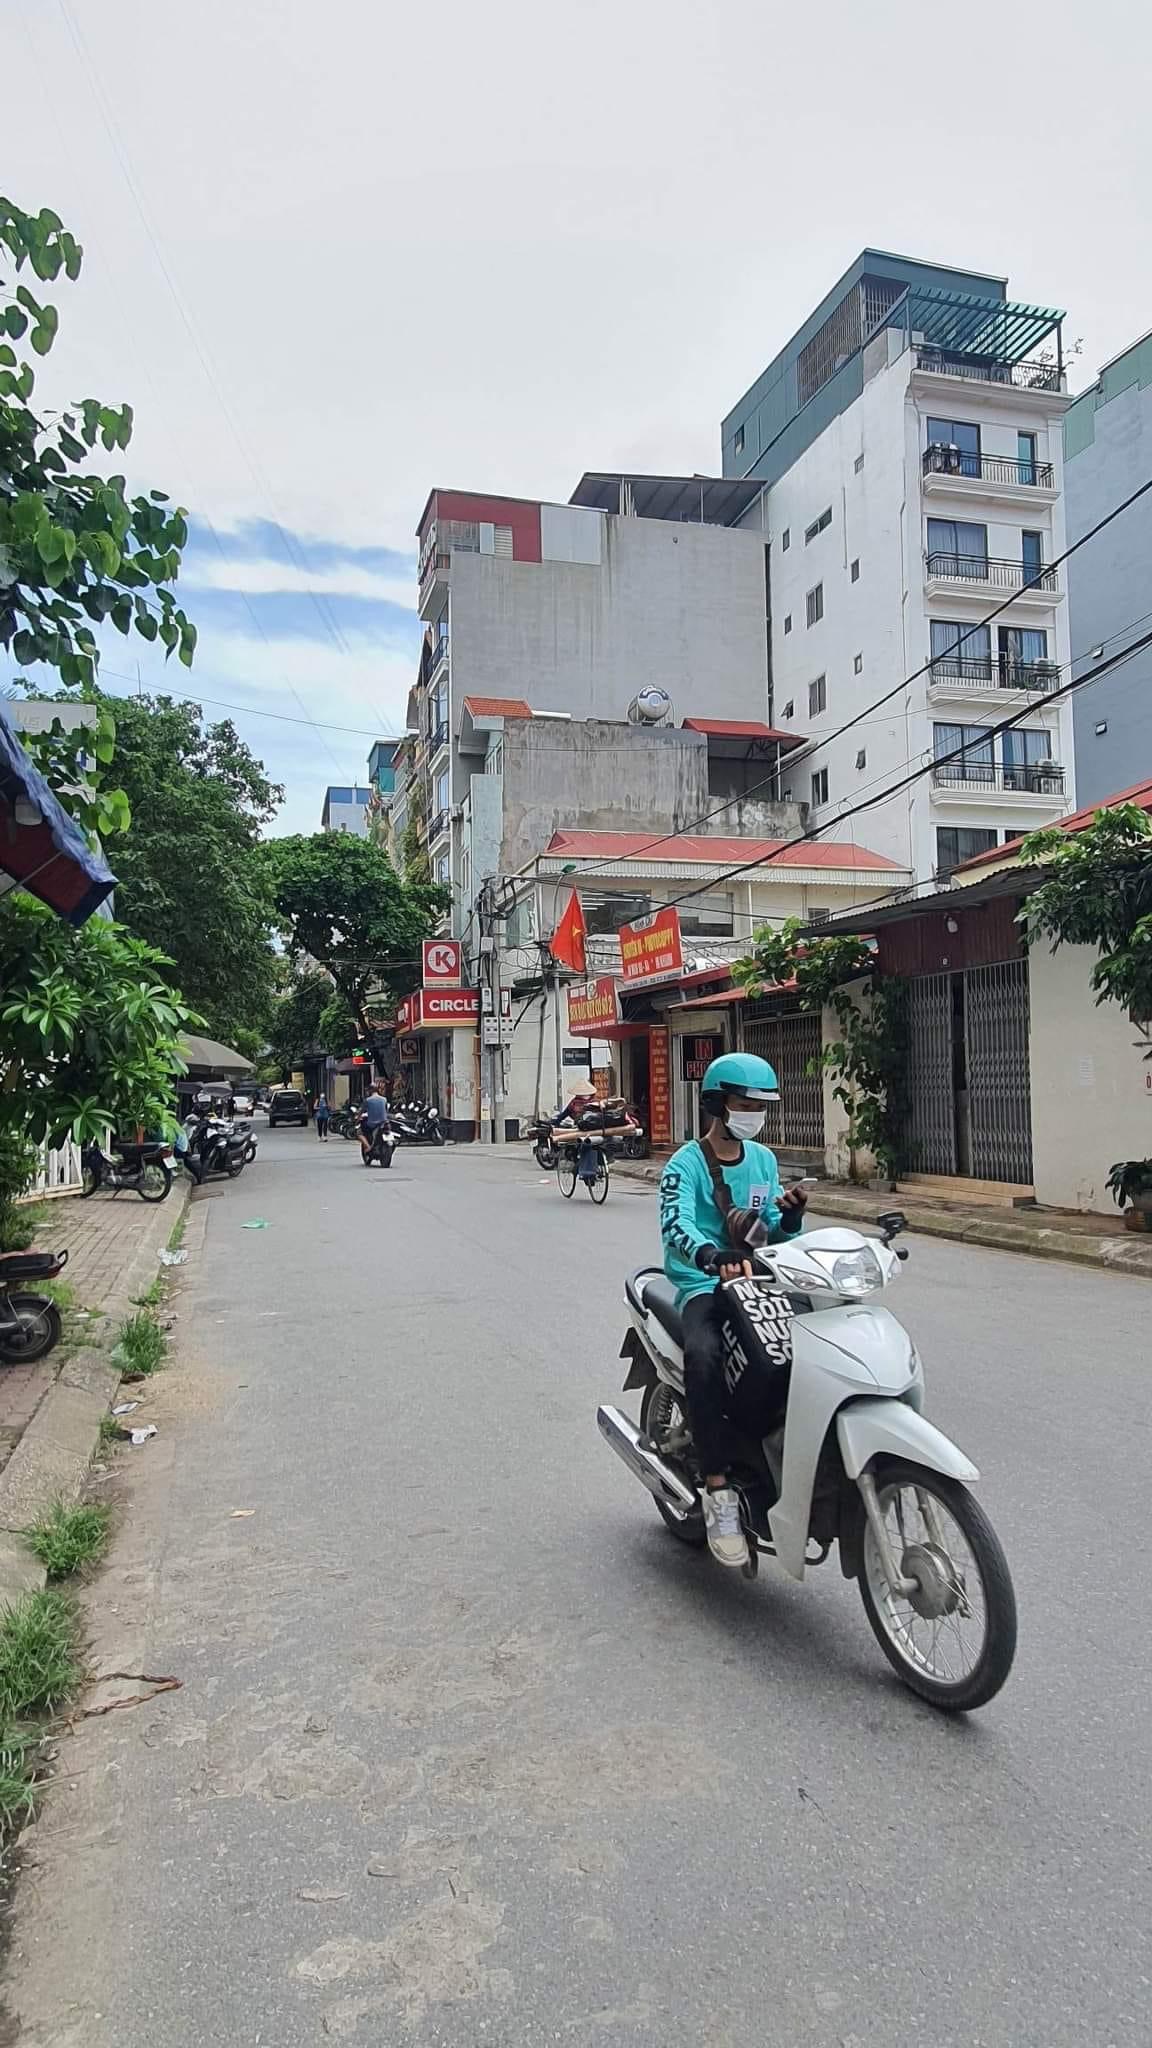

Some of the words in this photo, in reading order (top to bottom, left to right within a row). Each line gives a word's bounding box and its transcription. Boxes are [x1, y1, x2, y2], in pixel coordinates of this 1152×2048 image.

[429, 998, 479, 1012] CIRCLE
[608, 994, 614, 1015] 2
[695, 1039, 713, 1060] IN
